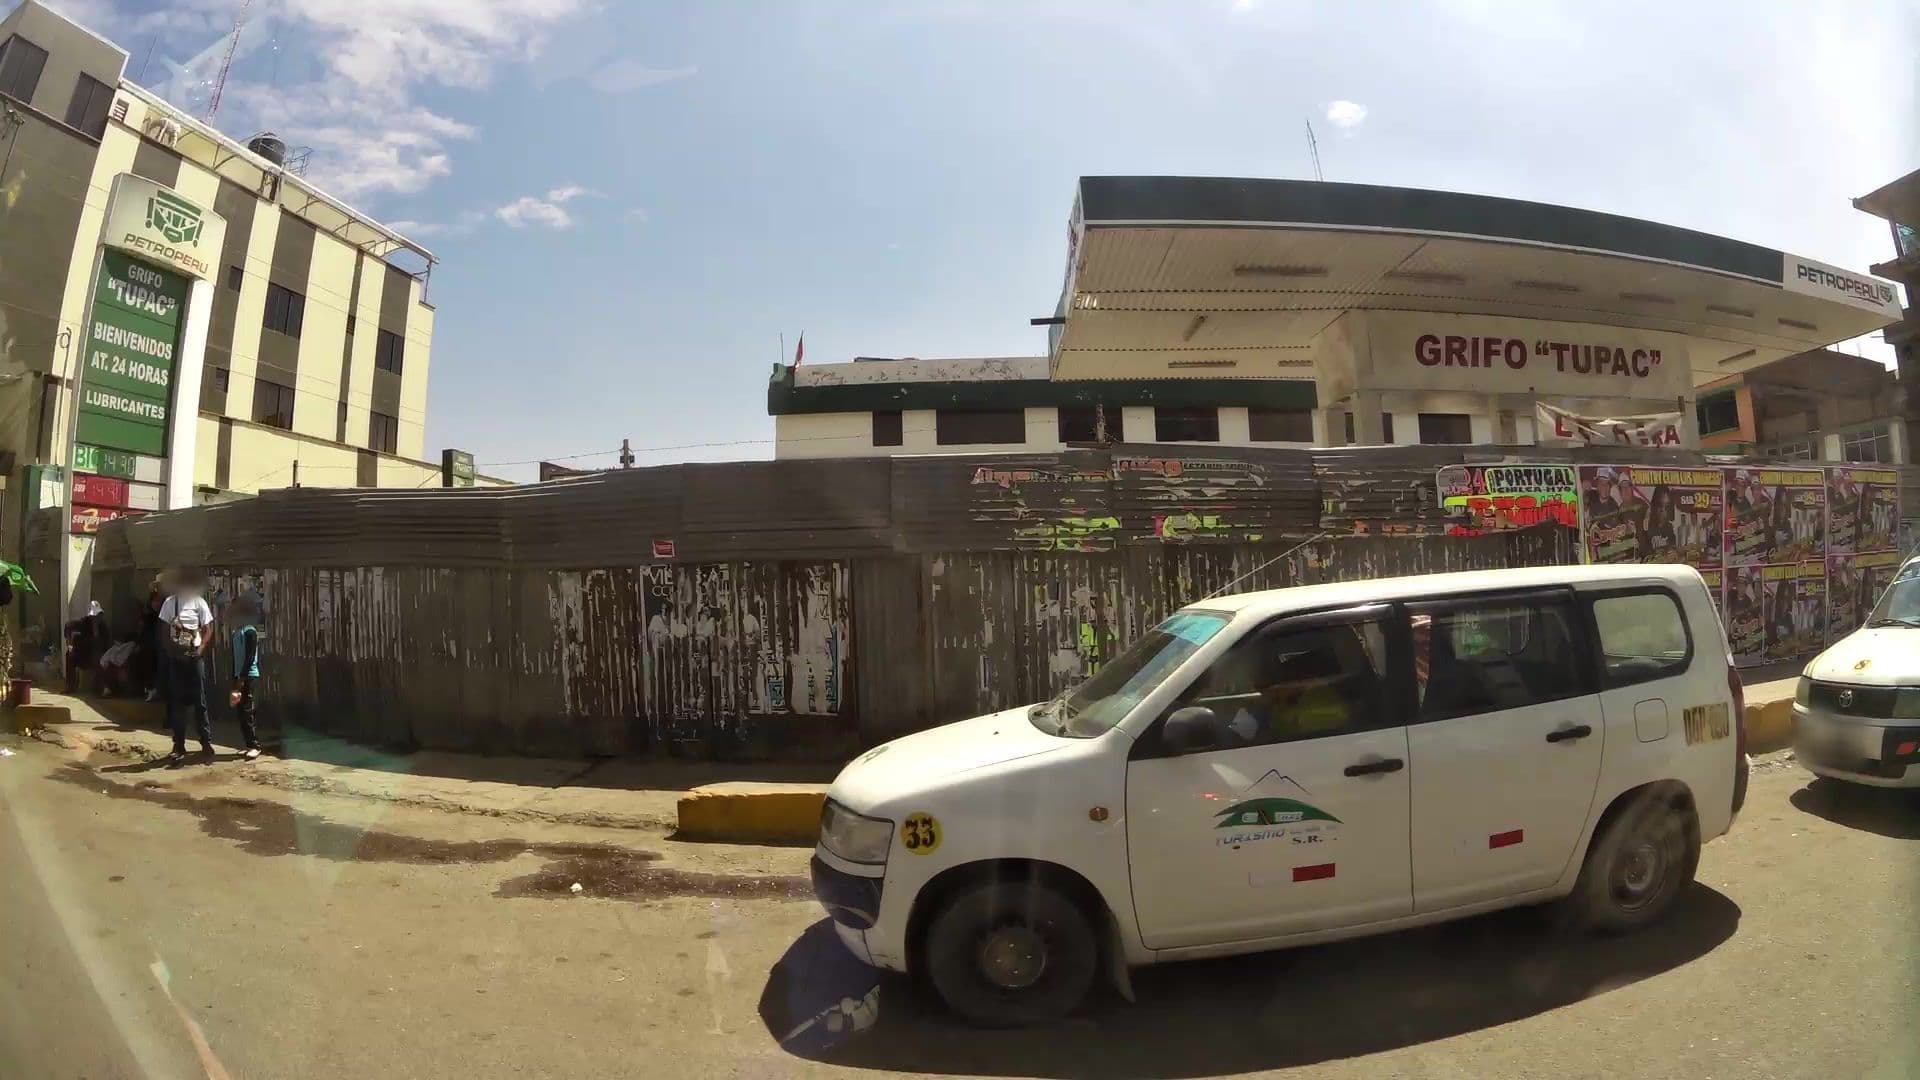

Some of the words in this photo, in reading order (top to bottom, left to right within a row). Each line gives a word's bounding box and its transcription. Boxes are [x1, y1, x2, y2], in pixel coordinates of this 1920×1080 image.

[123, 233, 209, 274] PETROPERU
[128, 264, 163, 289] GRIFO
[1797, 263, 1879, 299] PETROPERU
[94, 321, 173, 361] BIENVENIDOS
[1415, 334, 1527, 369] GRIFO
[91, 350, 109, 371] AT.
[111, 356, 126, 376] 24
[128, 360, 169, 386] HORAS
[86, 389, 165, 420] LUBRICANTES
[1494, 469, 1574, 487] PORTUGAL
[904, 816, 936, 849] 33
